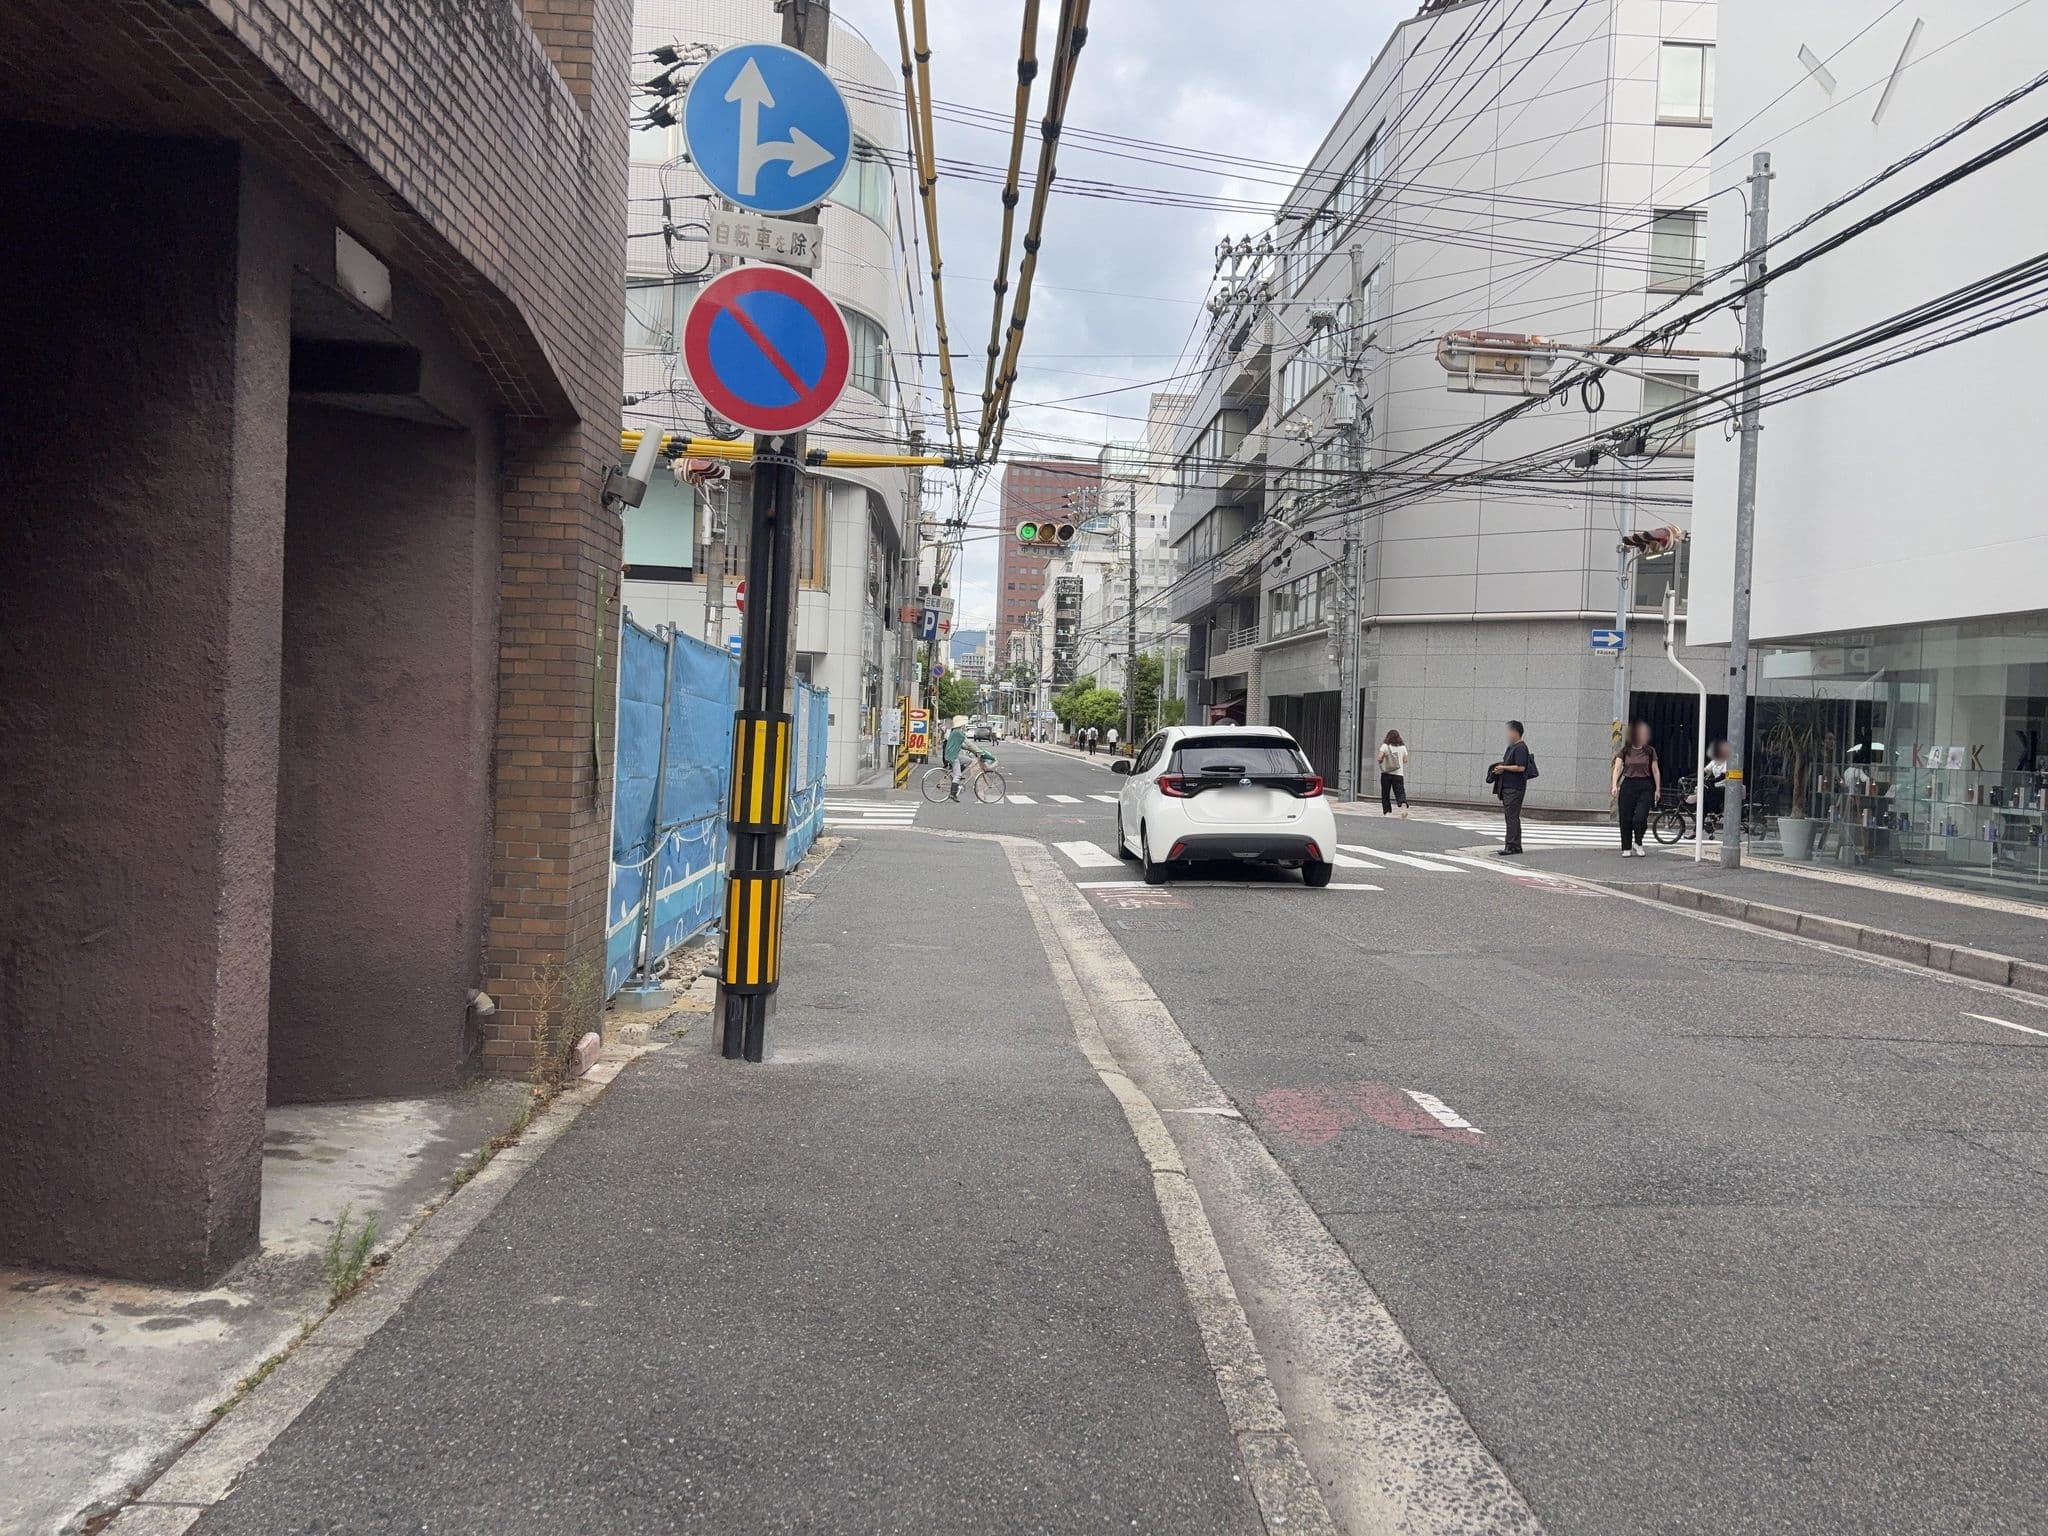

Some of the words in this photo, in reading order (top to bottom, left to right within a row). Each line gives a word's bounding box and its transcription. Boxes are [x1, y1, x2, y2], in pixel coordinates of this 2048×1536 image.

[716, 221, 818, 259] 自転車を除く
[923, 611, 936, 637] P
[909, 721, 924, 732] P
